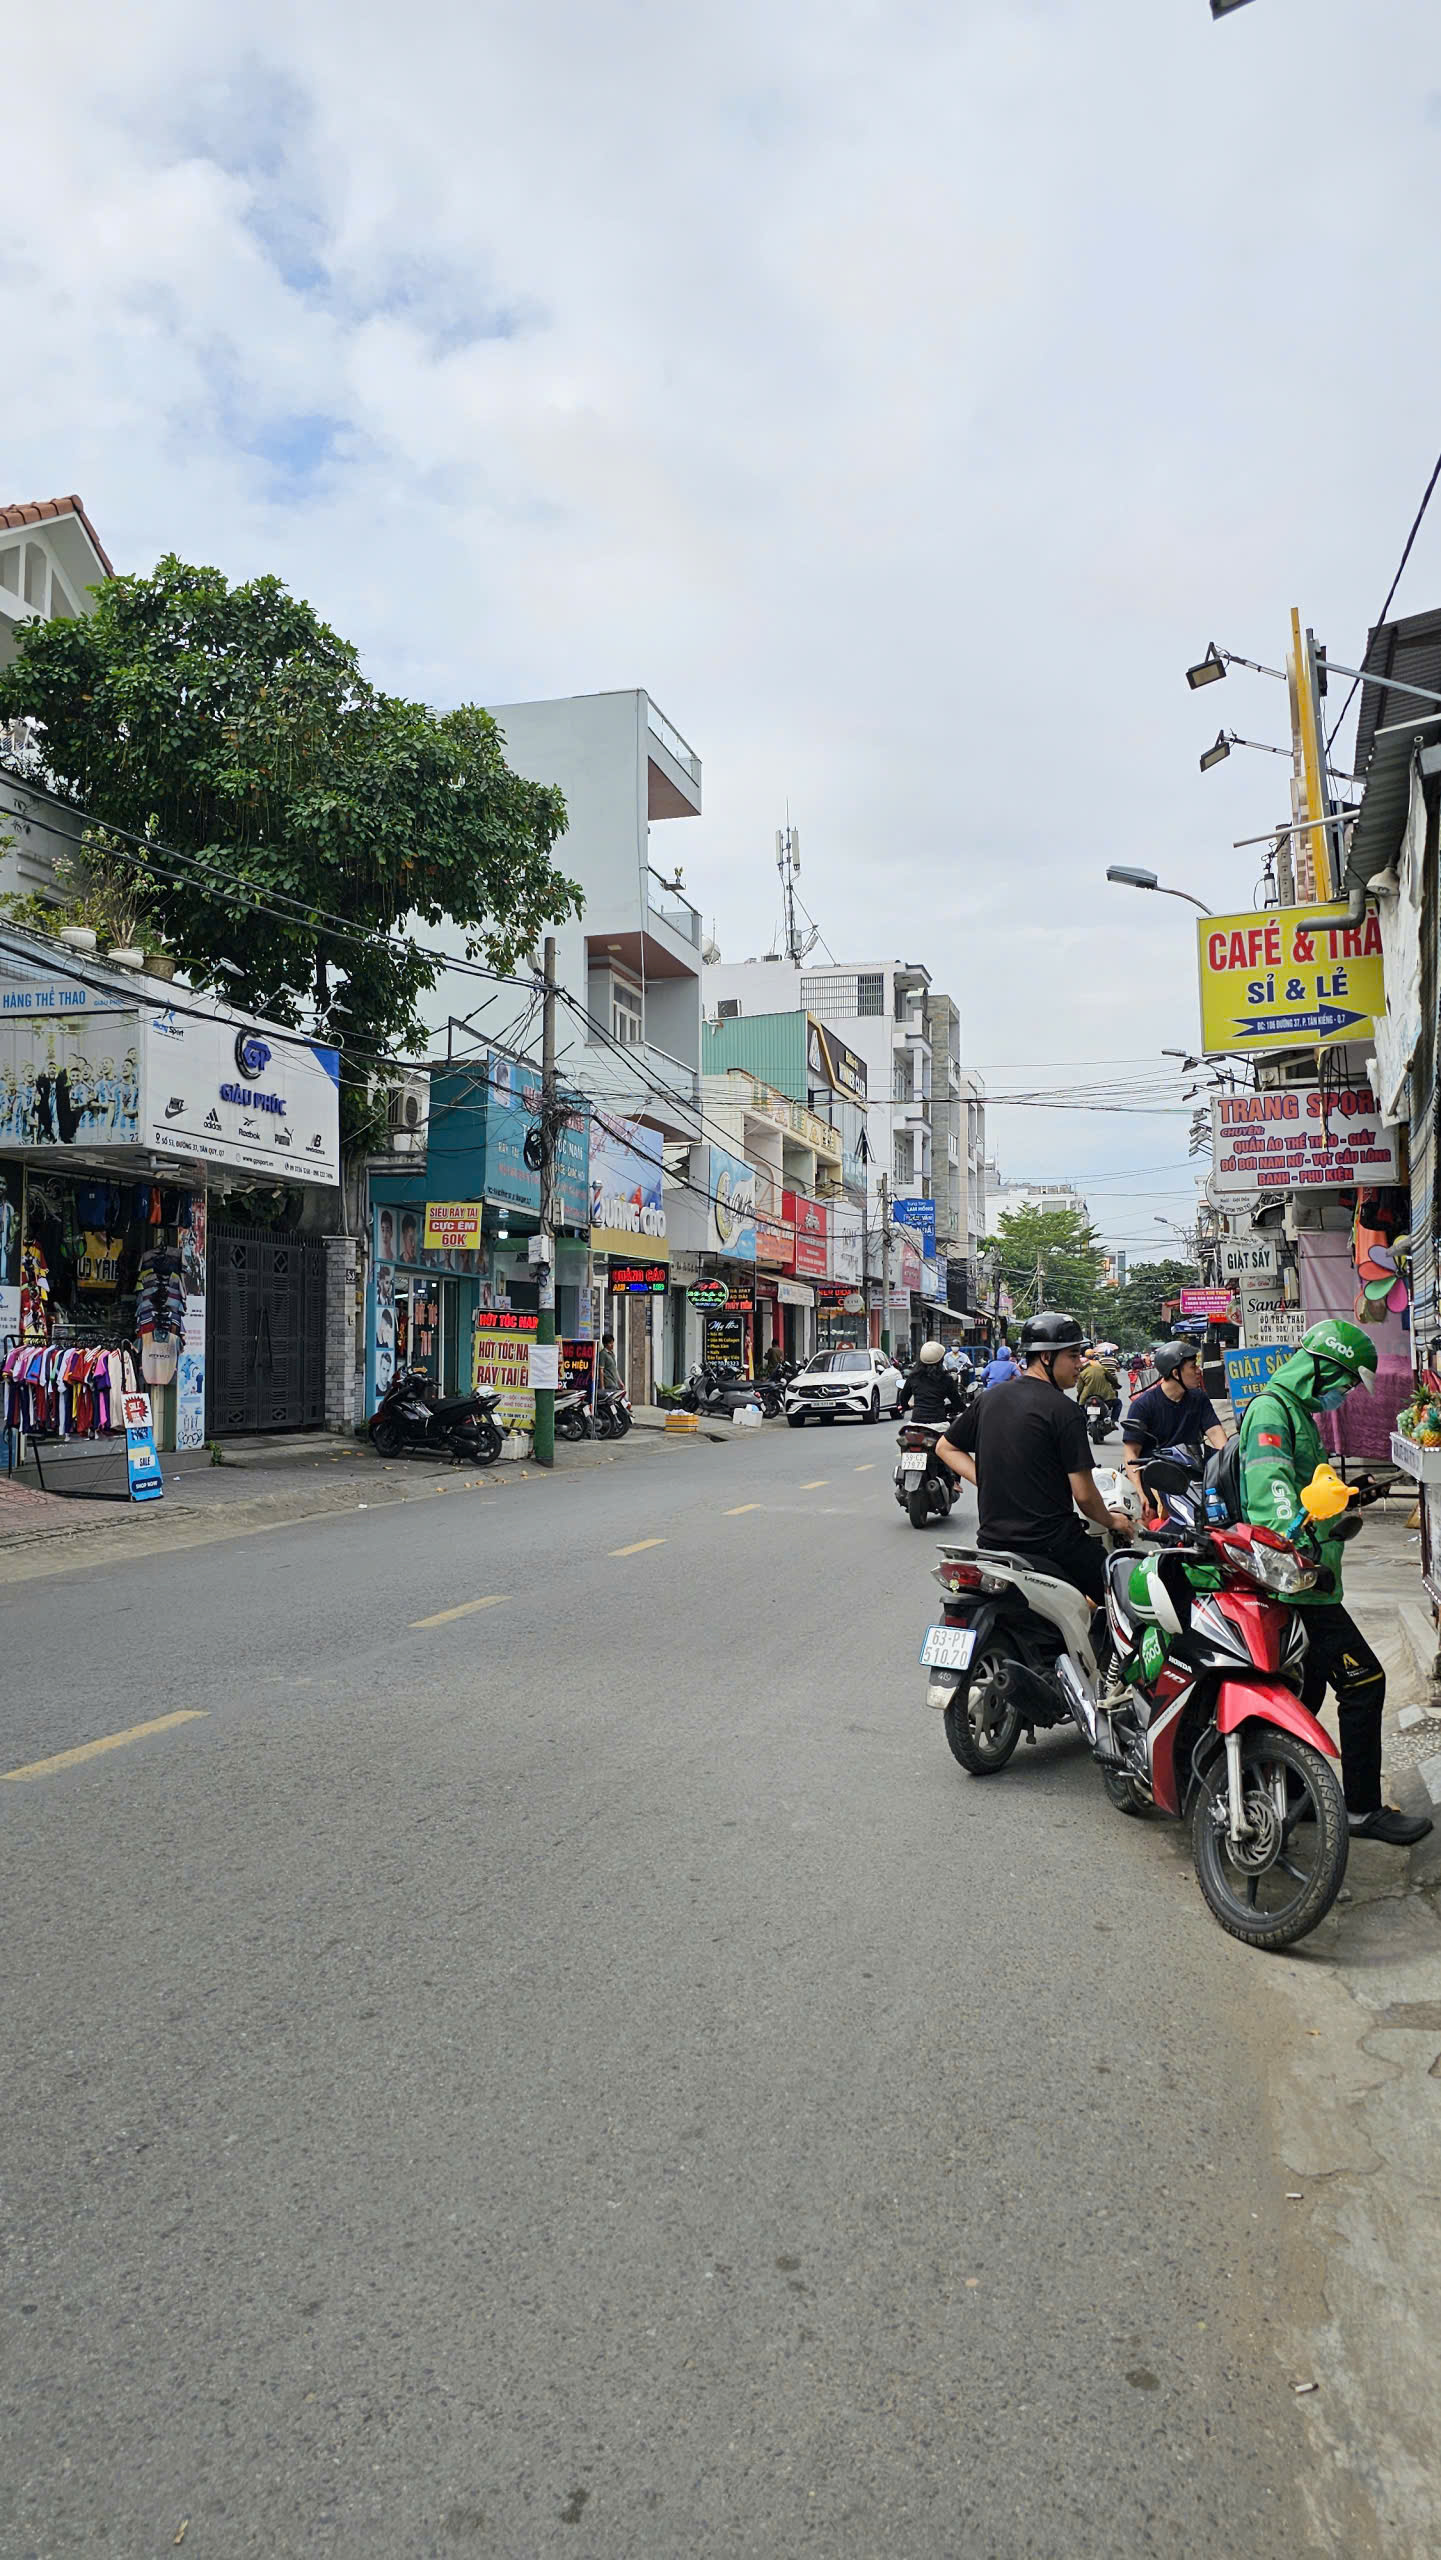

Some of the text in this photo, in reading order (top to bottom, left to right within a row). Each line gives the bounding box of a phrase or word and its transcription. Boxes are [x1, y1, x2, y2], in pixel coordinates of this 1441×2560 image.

[1209, 909, 1384, 971] CAFÉ & TRÀ
[1248, 966, 1348, 1004] SỈ & LẺ
[3, 985, 86, 1009] HÀNG THỂ THAO
[253, 1093, 287, 1117] PHÚC
[1218, 1089, 1382, 1124] TRANG SPOR
[203, 1120, 223, 1132] adidas
[1220, 1125, 1265, 1137] CHUYÊN:
[1267, 1136, 1283, 1151] ÁO
[1259, 1156, 1285, 1169] NAM
[1257, 1172, 1290, 1186] BANH
[1300, 1169, 1324, 1184] PHỤ
[1325, 1166, 1354, 1182] KIỆN
[430, 1205, 448, 1217] SIÊU
[467, 1207, 478, 1217] TAI
[641, 1202, 667, 1238] CÁO
[432, 1220, 475, 1232] CỰC ÊM
[1252, 1245, 1271, 1269] SẤY
[645, 1266, 666, 1282] CÁO
[479, 1312, 517, 1327] HỚT TÓC
[1287, 1315, 1305, 1324] THAO
[478, 1338, 496, 1359] HỚT
[516, 1344, 529, 1361] NA
[1325, 1336, 1355, 1359] Grab
[571, 1360, 589, 1371] HIỆU
[1228, 1355, 1261, 1381] GIẶT
[501, 1367, 518, 1386] TAI
[139, 1456, 151, 1467] SALE
[1271, 1480, 1292, 1520] Gra
[1024, 1575, 1058, 1589] VISION
[932, 1629, 968, 1649] 63-P1
[923, 1647, 968, 1667] 510.70
[1168, 1655, 1193, 1674] HONDA
[1163, 1670, 1186, 1684] 110
